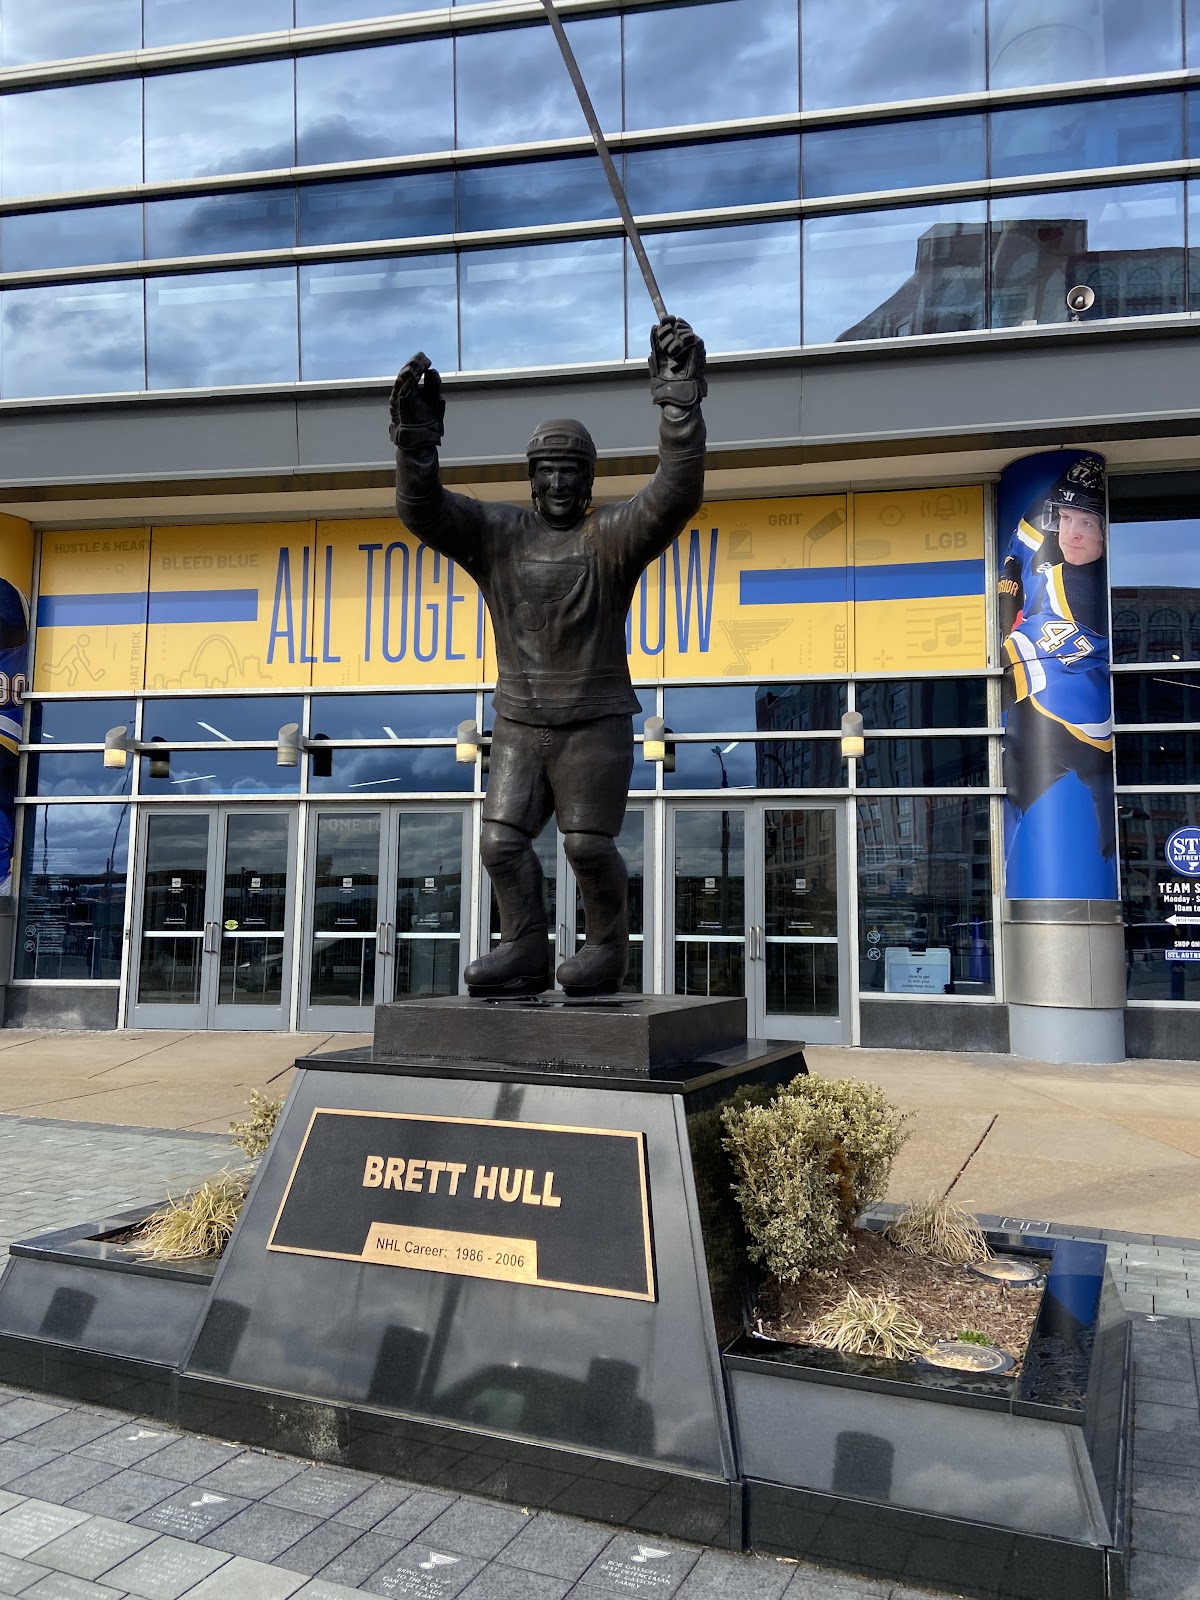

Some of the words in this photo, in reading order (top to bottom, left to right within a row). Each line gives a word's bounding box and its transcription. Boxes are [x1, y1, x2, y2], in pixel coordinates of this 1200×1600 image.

[768, 513, 802, 526] GRIT
[55, 543, 100, 553] HUSTLE
[103, 541, 111, 551] &
[114, 540, 154, 551] HEART
[924, 532, 968, 550] LGB
[162, 555, 213, 570] BLEED
[218, 554, 259, 568] BLUE
[267, 545, 341, 664] ALL
[131, 631, 141, 662] TRICK
[834, 623, 846, 669] CHEER
[1036, 621, 1095, 666] 47
[130, 663, 139, 686] HAT
[1173, 838, 1200, 855] ST
[1158, 882, 1190, 893] TEAM
[1164, 895, 1190, 904] Monday
[362, 1155, 467, 1196] BRETT
[473, 1165, 561, 1207] HULL
[376, 1238, 400, 1251] NHL
[404, 1241, 447, 1258] Career:
[456, 1247, 483, 1262] 1986
[495, 1252, 524, 1267] 2006
[382, 1576, 399, 1584] CAN
[396, 1568, 418, 1576] BRING
[415, 1591, 435, 1599] TEAM
